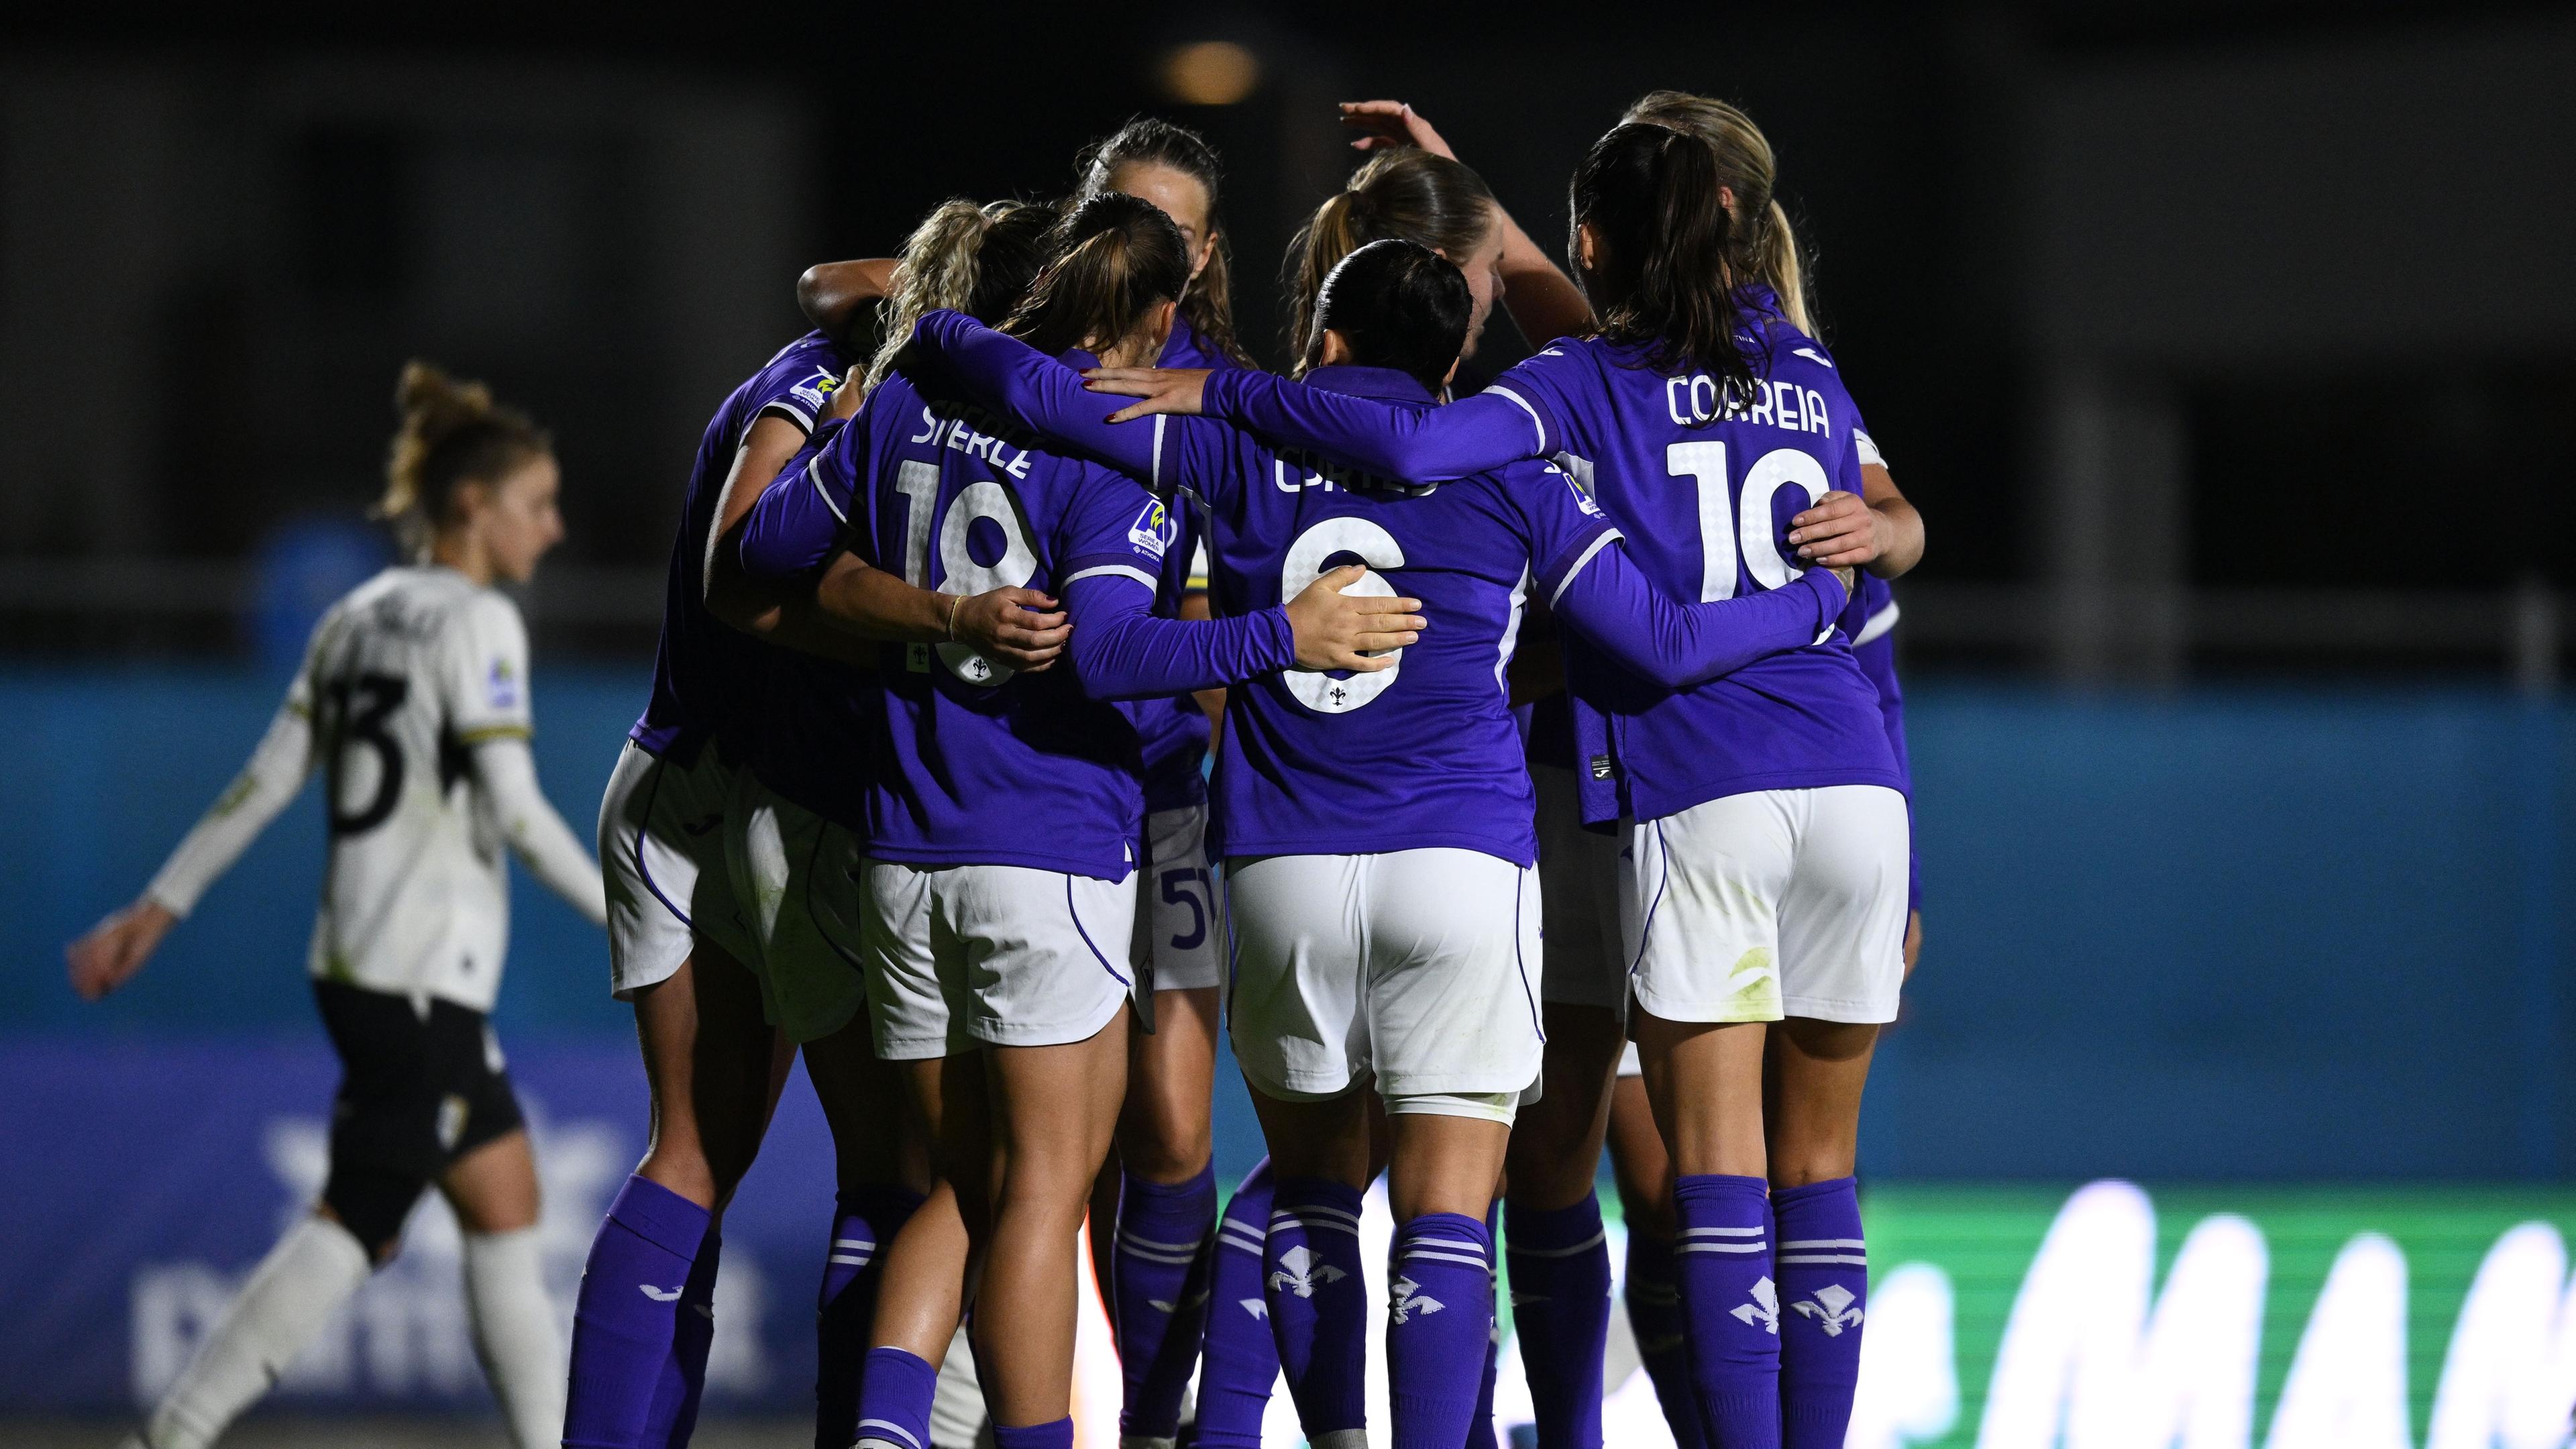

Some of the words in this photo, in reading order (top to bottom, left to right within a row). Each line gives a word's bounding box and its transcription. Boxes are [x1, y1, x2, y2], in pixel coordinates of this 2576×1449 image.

[1666, 374, 1829, 439] CORREIA
[1138, 537, 1159, 551] WOMEN
[1141, 549, 1160, 563] ATHORA
[1282, 516, 1405, 714] 6
